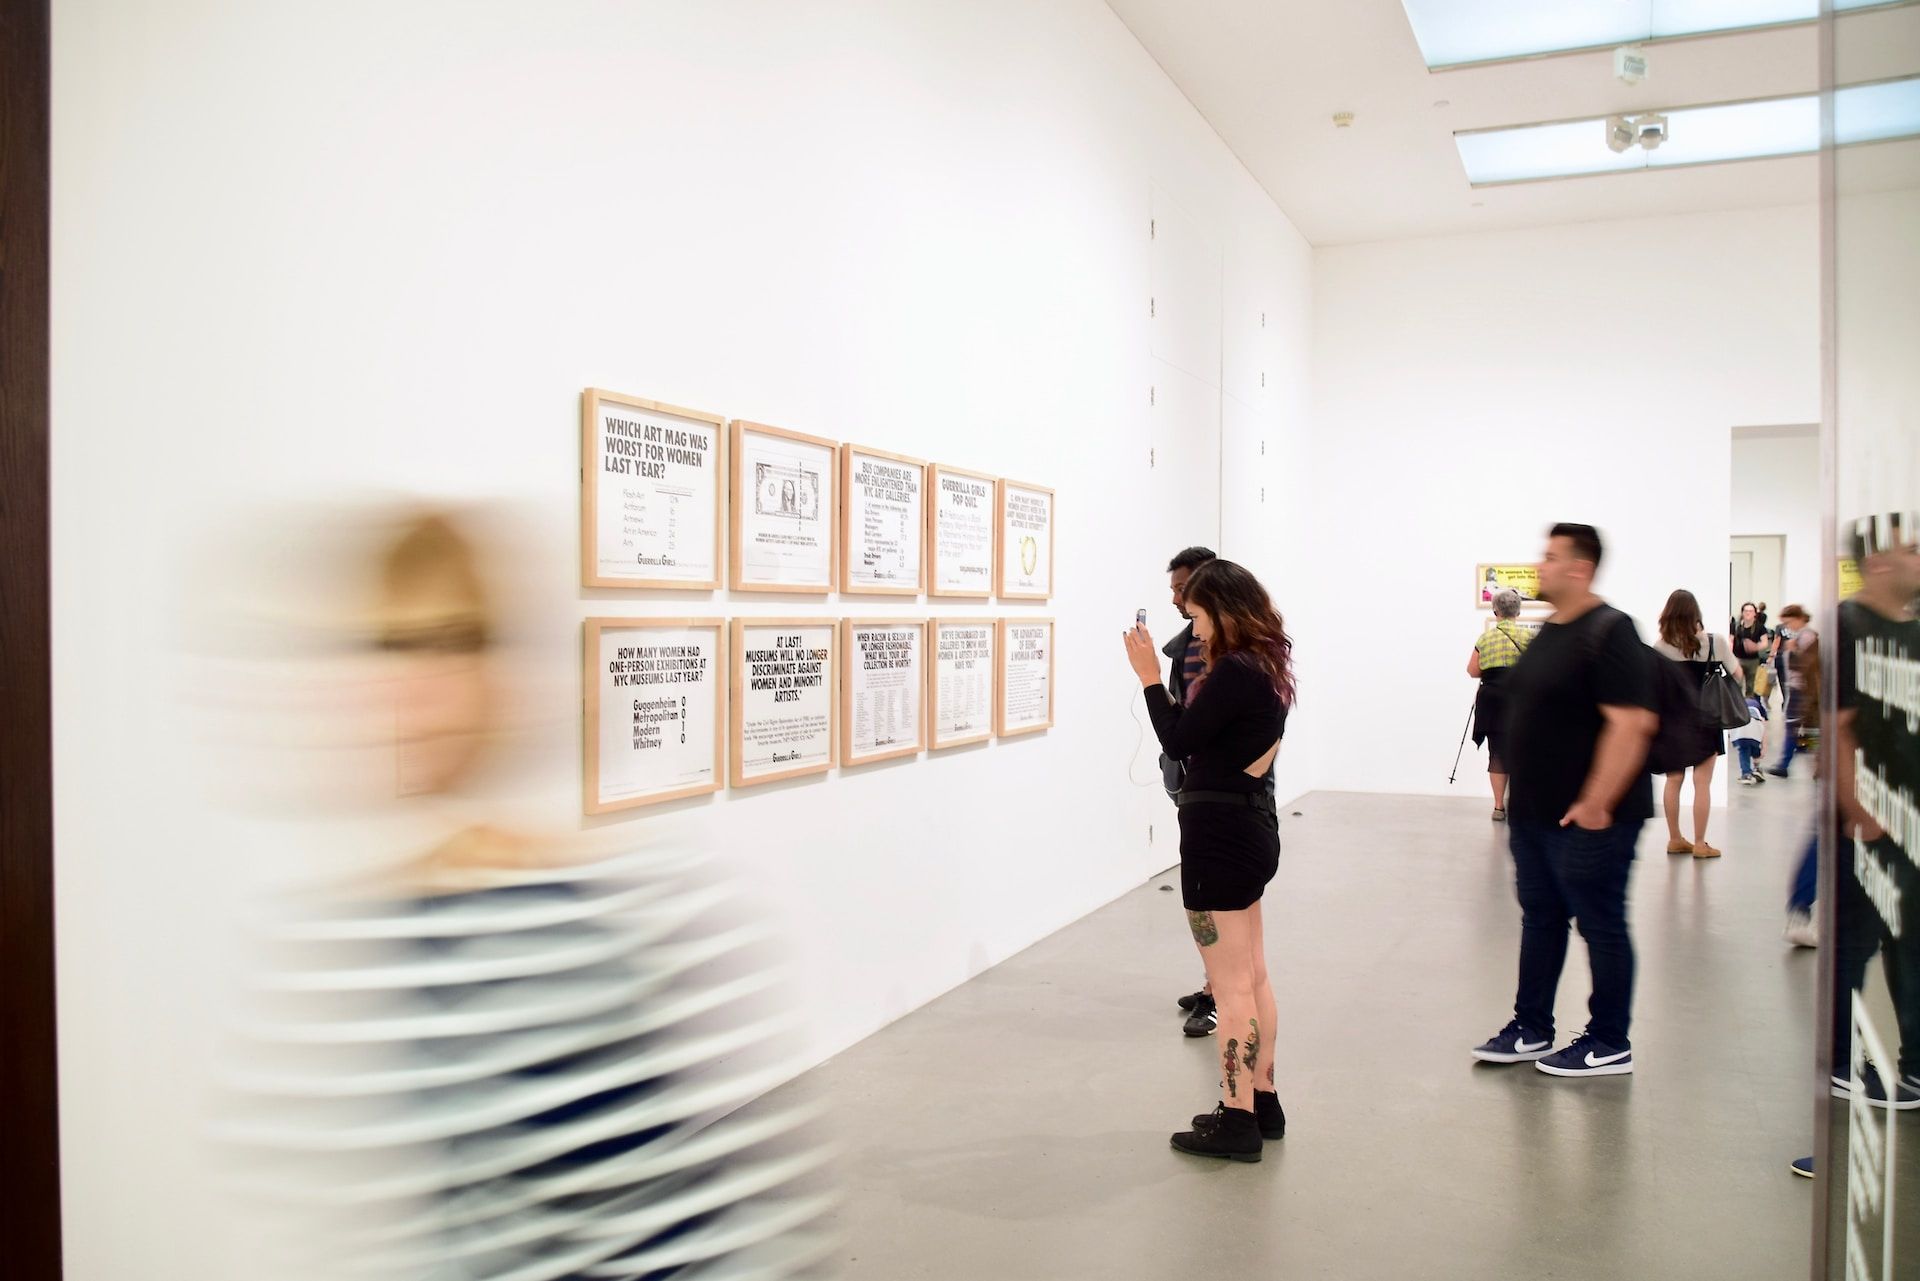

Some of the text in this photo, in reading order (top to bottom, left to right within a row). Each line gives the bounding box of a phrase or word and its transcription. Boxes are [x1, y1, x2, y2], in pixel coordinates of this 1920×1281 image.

[605, 417, 707, 450] WHICH ART MAG WAS
[605, 436, 702, 467] WORST FOR WOMEN
[605, 456, 665, 479] LAST YEAR?
[862, 462, 911, 481] BUS COMPANIES ARE
[855, 472, 917, 493] MORE ENLIGHTENED THAN
[942, 478, 985, 497] GUERRILLA GIRLS
[864, 486, 911, 503] NYC ART GALLERIES.
[953, 494, 963, 505] POP
[857, 633, 869, 641] WHEN
[872, 632, 886, 641] RACISM
[892, 632, 906, 641] SEXISM
[1020, 629, 1043, 639] ADVANTAGES
[777, 636, 802, 648] AT LAST!
[861, 642, 867, 651] NO
[869, 642, 884, 651] LONGER
[940, 641, 960, 650] GALLERIES
[961, 641, 965, 649] TO
[966, 640, 977, 649] SHOW
[1019, 640, 1037, 650] OF BEING
[618, 646, 700, 659] HOW MANY WOMEN HAD
[746, 649, 828, 662] MUSEUMS WILL NO LONGER
[865, 651, 877, 660] WHAT
[879, 651, 887, 660] WILL
[889, 651, 899, 659] YOUR
[938, 651, 953, 660] WOMEN
[959, 651, 972, 659] ARTISTS
[974, 650, 977, 658] OF
[1011, 651, 1014, 661] A
[1015, 651, 1030, 660] WOMAN
[610, 658, 706, 673] ONE-PERSON EXHIBITIONS AT
[752, 662, 822, 676] DISCRIMINATE AGAINST
[864, 659, 911, 670] COLLECTION BE WORTH?
[955, 660, 974, 669] HAVE YOU?
[614, 670, 703, 687] NYC MUSEUMS LAST YEAR?
[751, 675, 822, 690] WOMEN AND MINORITY
[634, 696, 686, 712] Guggenheim 0
[633, 708, 686, 724] Metropolitan 0
[633, 721, 685, 737] Modern 1
[633, 733, 685, 750] Whitney 0
